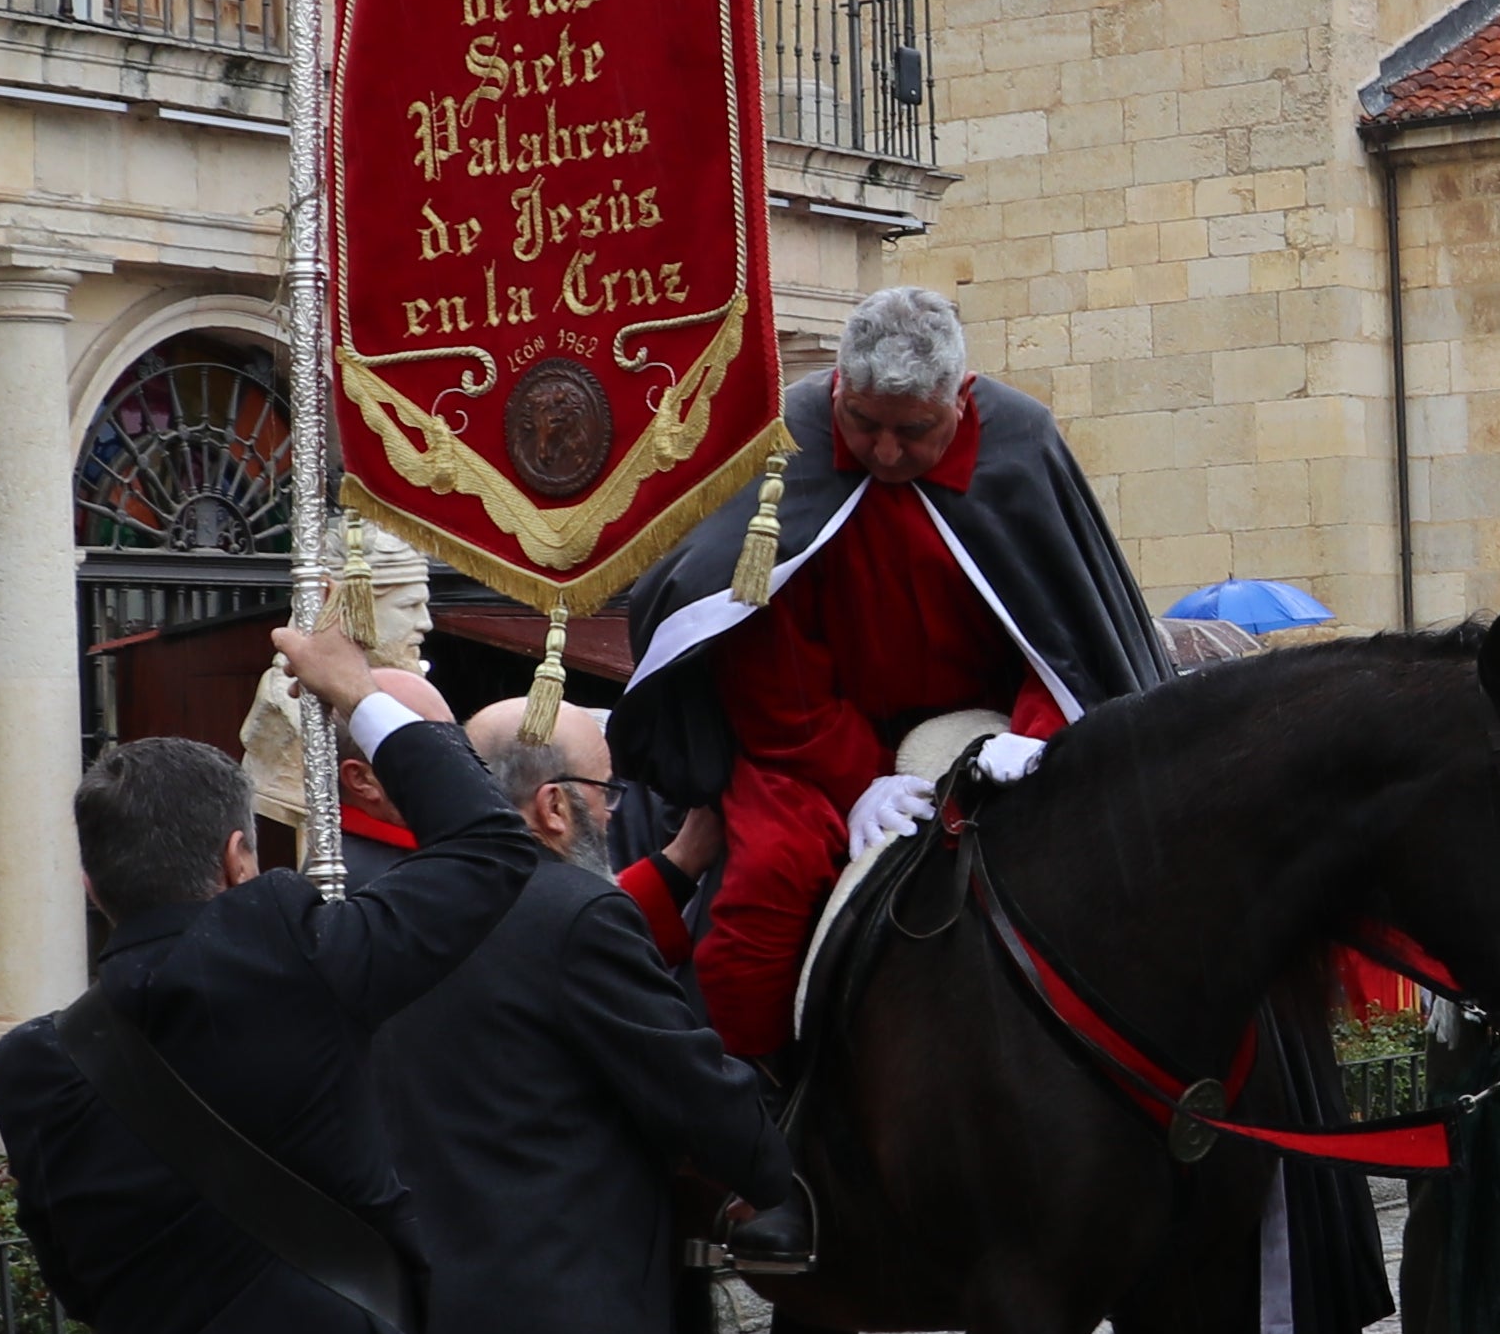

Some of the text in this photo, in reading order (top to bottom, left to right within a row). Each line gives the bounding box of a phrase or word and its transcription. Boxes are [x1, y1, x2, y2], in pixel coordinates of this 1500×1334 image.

[459, 23, 606, 128] Siete
[406, 91, 651, 182] Palabras
[416, 174, 664, 262] de Jesús
[401, 248, 690, 338] en la Cruz
[507, 328, 599, 373] LEÓN 1962
